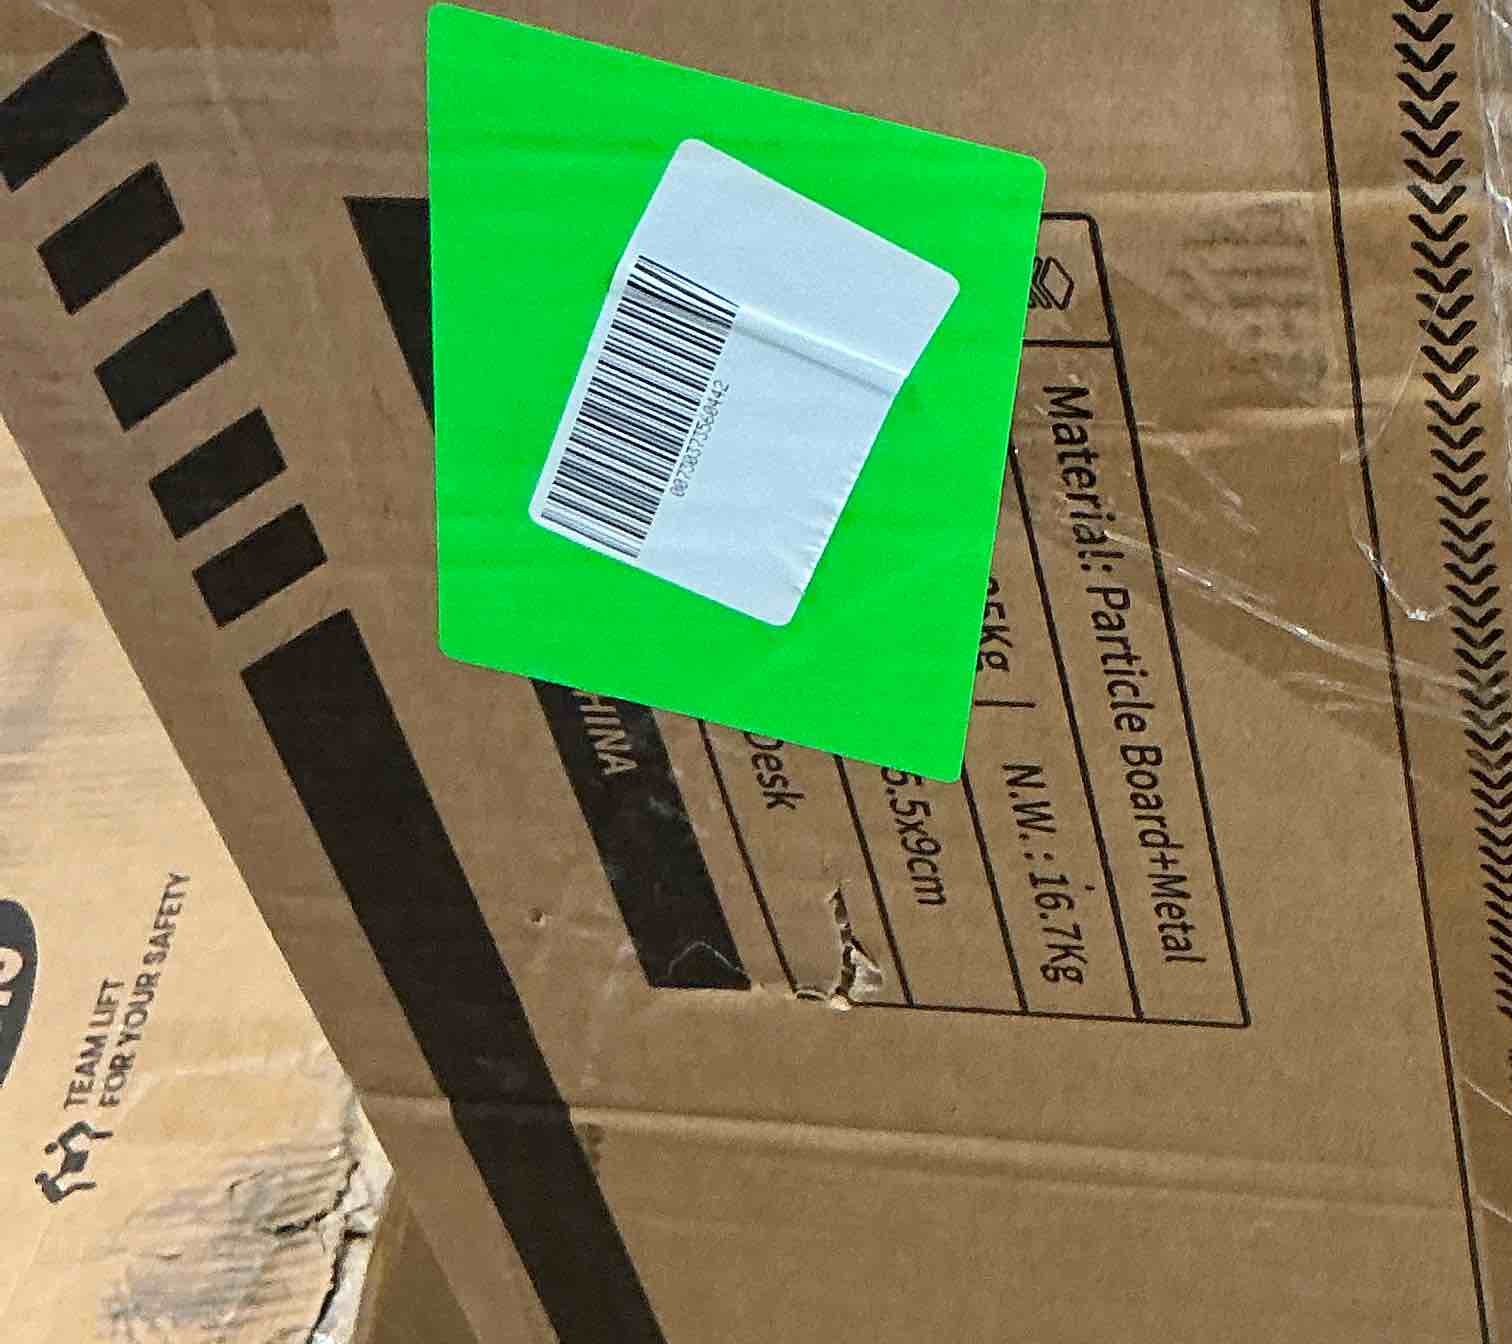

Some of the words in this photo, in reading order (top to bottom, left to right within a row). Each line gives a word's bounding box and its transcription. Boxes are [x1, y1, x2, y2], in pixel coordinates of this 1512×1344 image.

[1042, 384, 1126, 573] Material:
[573, 688, 639, 777] HINA
[1085, 586, 1156, 736] Particle
[880, 765, 949, 908] 5.5x9cm
[1119, 741, 1208, 964] Board+Metal
[98, 1053, 136, 1108] FOR
[117, 971, 161, 1048] YOUR
[143, 872, 191, 966] SAFETY
[1027, 872, 1089, 987] 16.7Kg
[64, 1034, 108, 1109] TEAM
[89, 977, 125, 1028] LIFT
